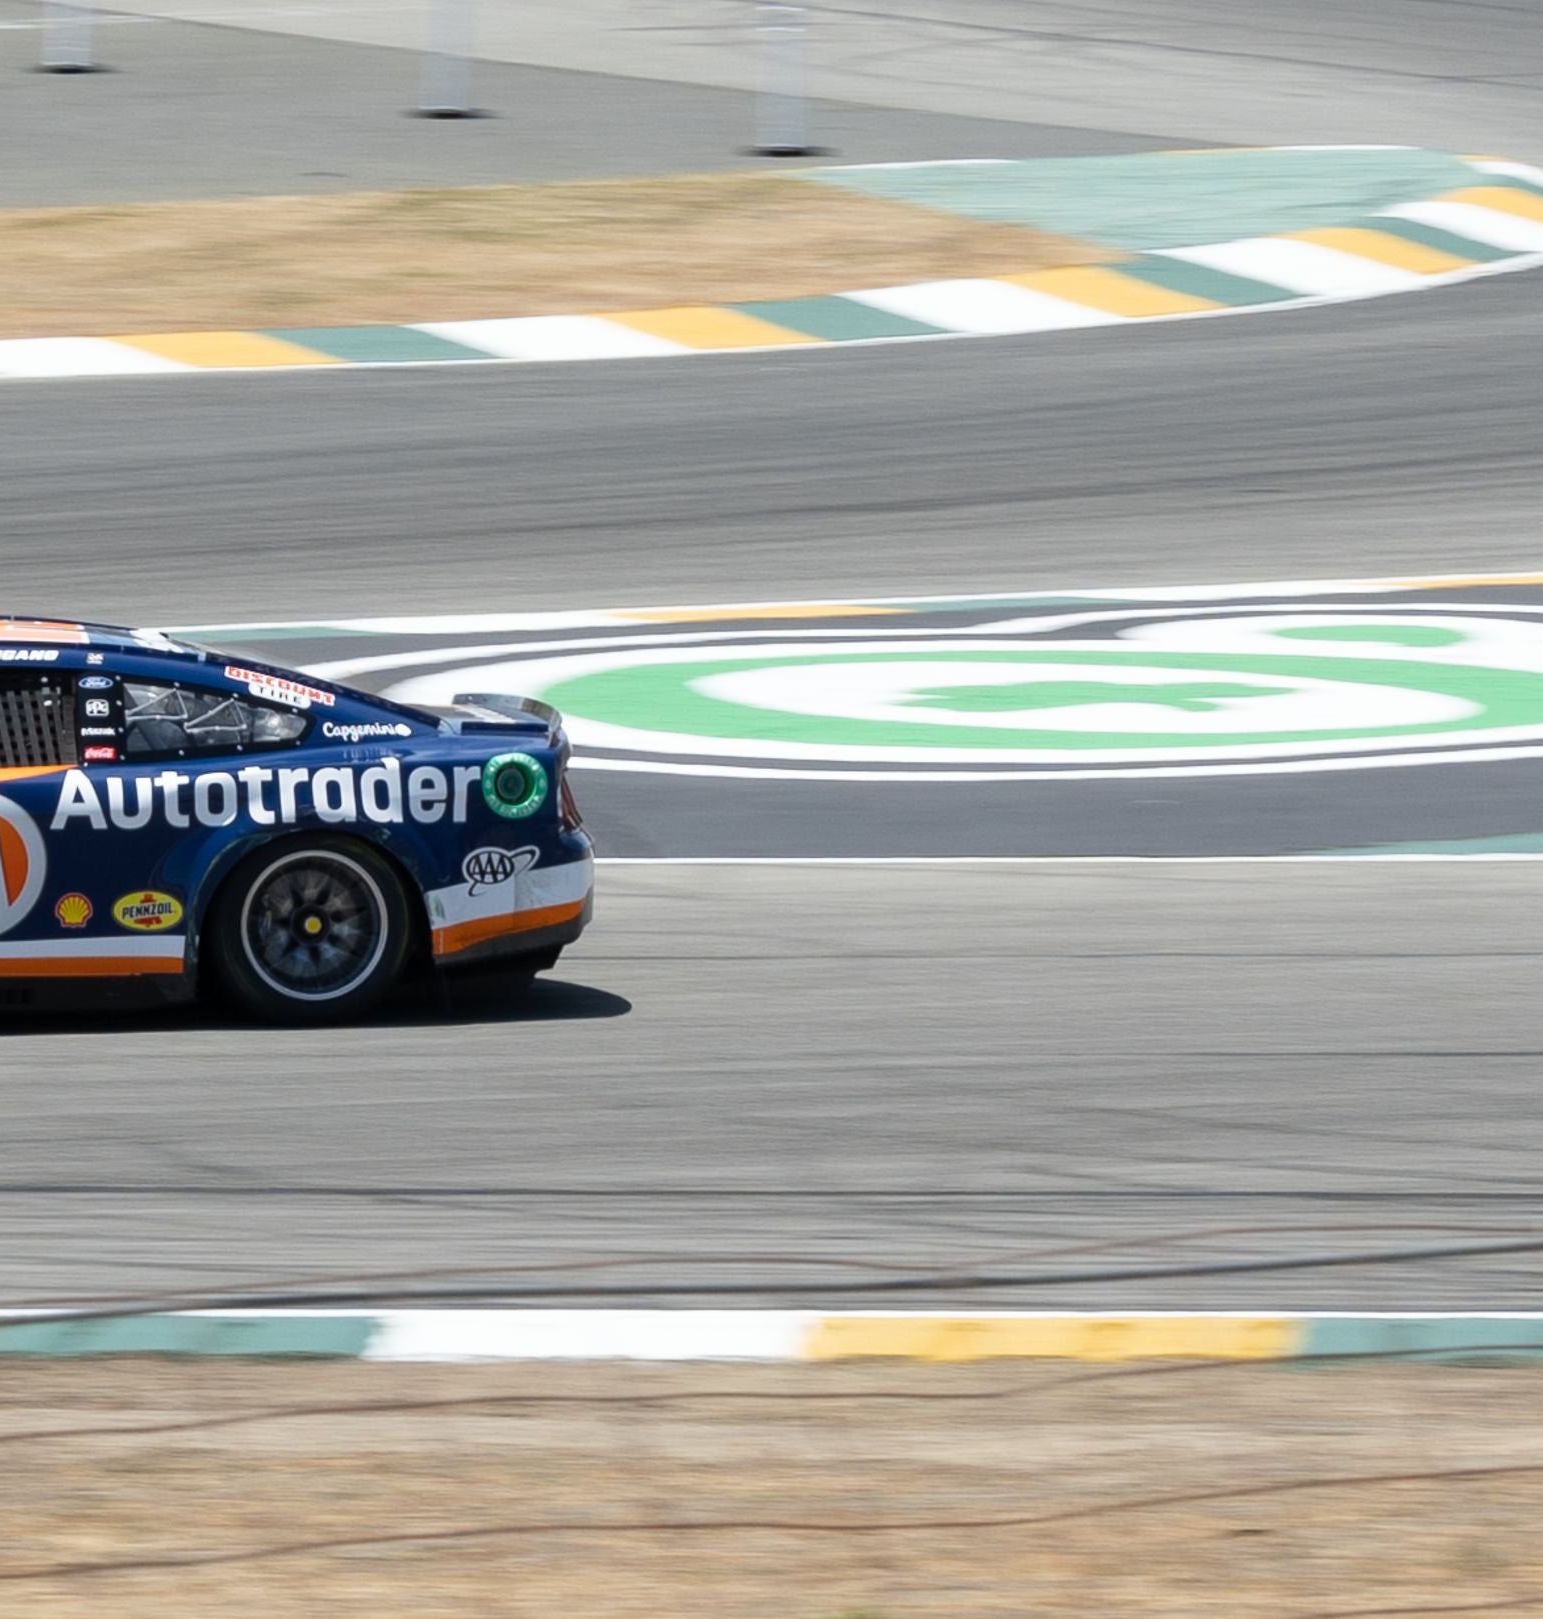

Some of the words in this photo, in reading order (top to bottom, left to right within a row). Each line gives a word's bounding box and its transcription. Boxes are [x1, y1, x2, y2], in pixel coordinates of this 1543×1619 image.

[228, 666, 333, 704] DISCOUNT
[258, 686, 303, 705] TIRE
[323, 722, 397, 741] Capgemini
[50, 756, 482, 831] Autotrader
[469, 851, 513, 884] AAA
[121, 902, 173, 919] PENNZOIL
